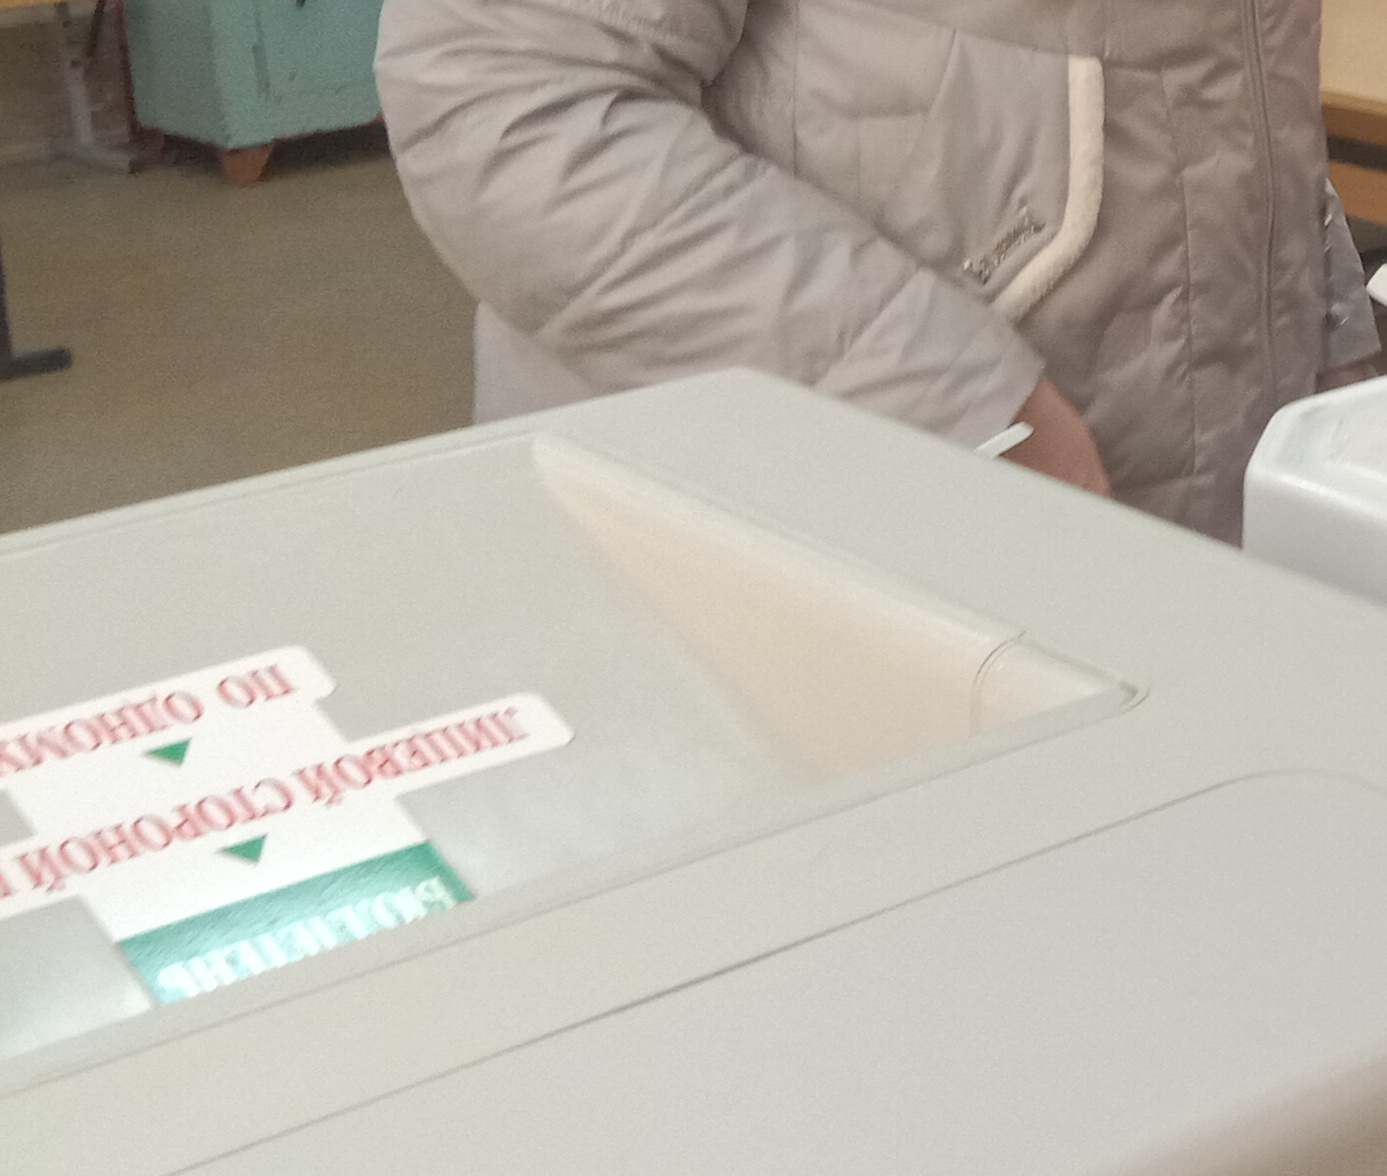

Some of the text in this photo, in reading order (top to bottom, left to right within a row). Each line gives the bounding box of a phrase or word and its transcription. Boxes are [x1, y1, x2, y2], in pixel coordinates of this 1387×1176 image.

[216, 663, 295, 709] ПО
[17, 705, 530, 892] ЛИЦЕВОЙ СТОРОНОЙ
